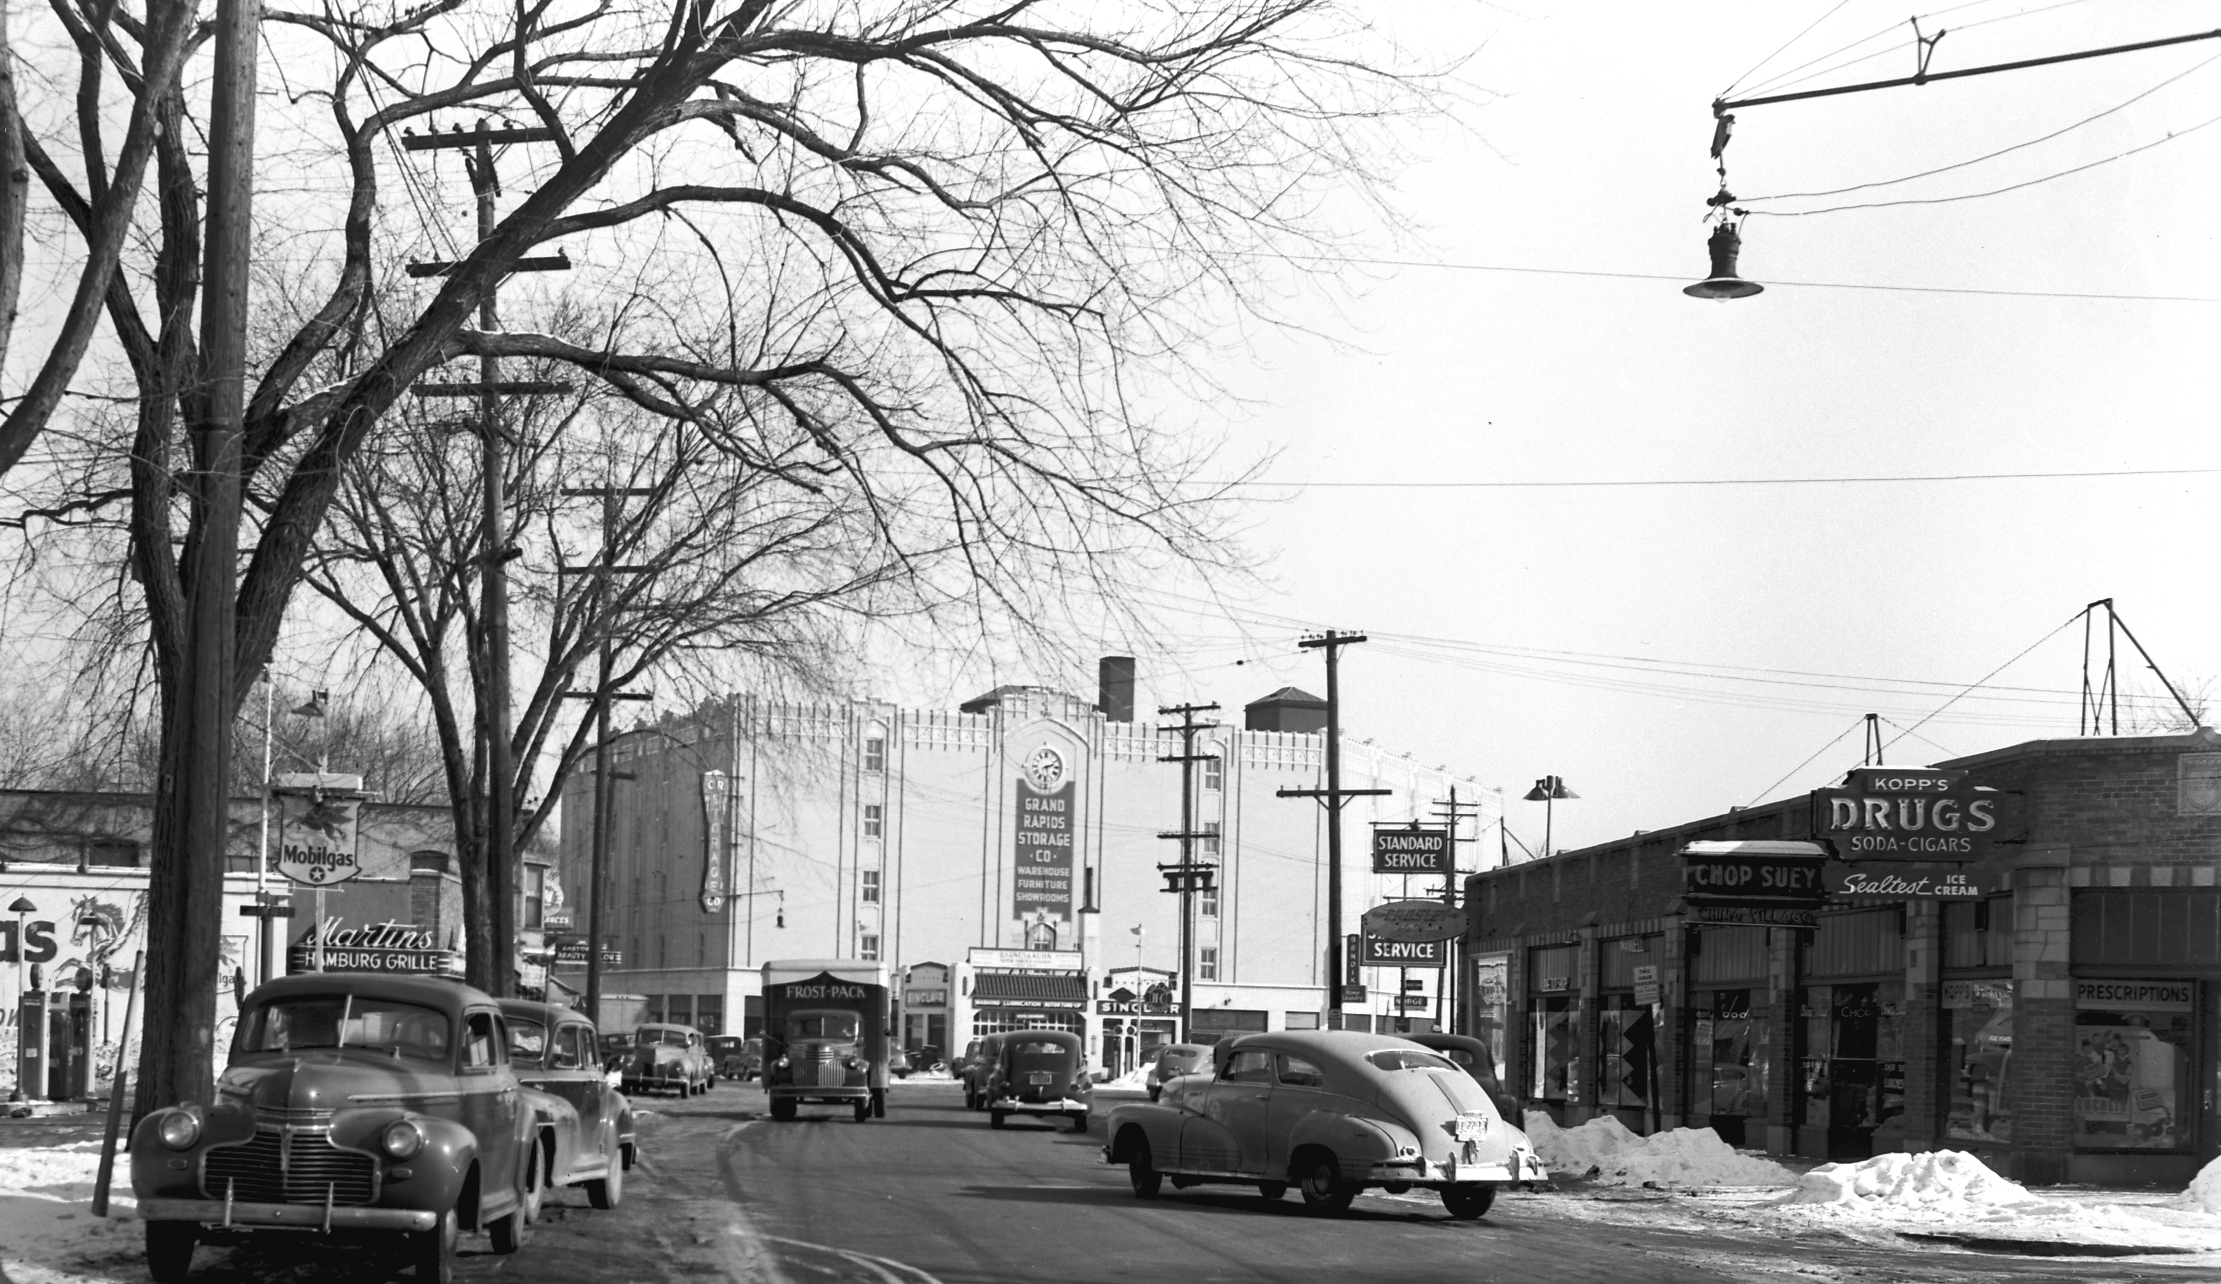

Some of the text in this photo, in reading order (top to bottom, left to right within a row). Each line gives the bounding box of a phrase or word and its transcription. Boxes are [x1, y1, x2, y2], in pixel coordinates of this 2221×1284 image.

[1874, 777, 1949, 791] KOPP'S
[1025, 798, 1065, 812] GRAND
[1023, 814, 1065, 829] RAPIDS
[1830, 797, 1995, 832] DRUGS
[1018, 832, 1070, 847] STORAGE
[1378, 836, 1443, 851] STANDARD
[1851, 836, 1971, 852] SODA-CIGARS
[283, 845, 353, 871] Mobilgas
[1384, 853, 1437, 868] SERVICE
[1017, 866, 1070, 877] WAREHOUSE
[1695, 863, 1816, 889] CHOP SUEY
[1018, 879, 1068, 890] FURNITURE
[1839, 873, 1932, 895] Sealtest
[1946, 874, 1966, 885] ICE
[1016, 892, 1069, 902] SHOWROOMS
[1934, 886, 1979, 896] CREAM
[1384, 908, 1451, 922] CROSLEY
[1698, 907, 1743, 921] CHINA
[1373, 942, 1434, 959] SERVICE
[386, 954, 438, 970] GRILLE
[786, 985, 867, 999] FROST-PACK
[907, 991, 945, 1004] SINCLAIR
[2077, 984, 2190, 1002] PRESCRIPTIONS
[1101, 1002, 1180, 1014] SINCLR
